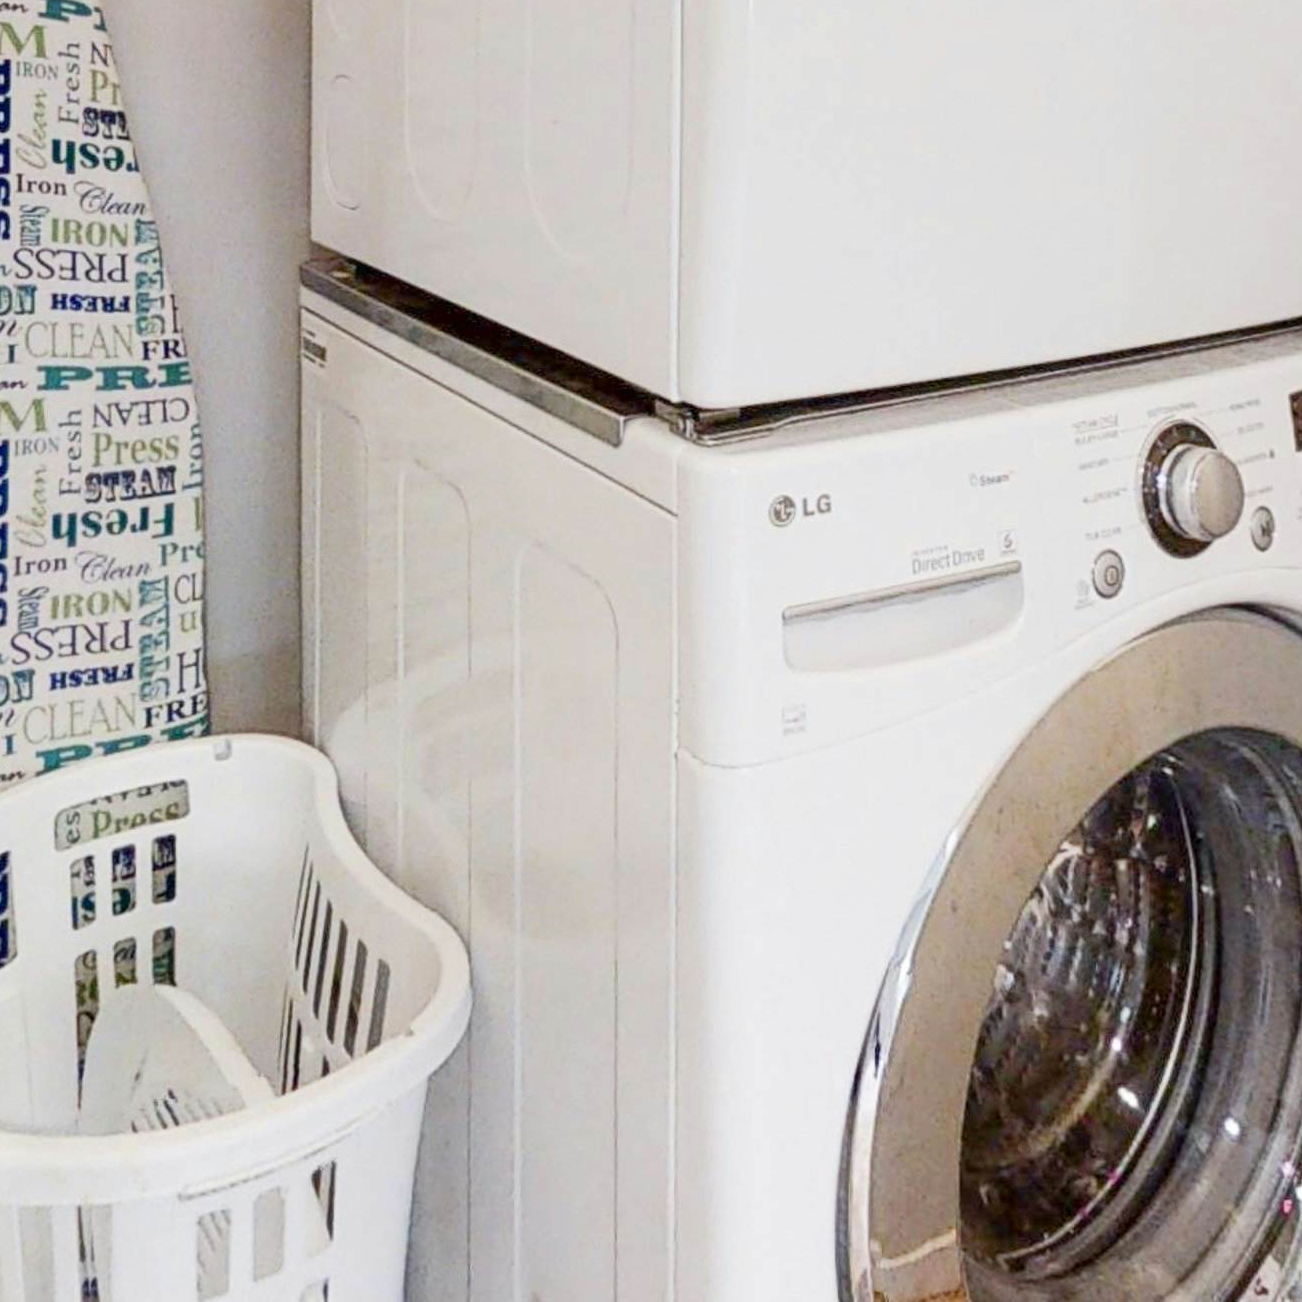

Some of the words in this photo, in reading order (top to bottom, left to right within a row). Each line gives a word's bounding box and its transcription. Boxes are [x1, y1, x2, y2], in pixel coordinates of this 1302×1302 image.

[16, 60, 59, 81] IRON
[57, 42, 80, 124] Fresh
[16, 173, 68, 196] Iron
[73, 180, 147, 216] Clean
[51, 217, 129, 247] IRON
[13, 247, 129, 283] PRESS
[50, 293, 131, 314] FRESH
[25, 321, 134, 360] CLEAN
[91, 397, 191, 429] CLEAN
[14, 437, 60, 458] IRON
[58, 409, 82, 496] Fresh
[91, 431, 180, 467] Press
[84, 464, 178, 504] STEAM
[13, 463, 47, 548] Clean
[802, 494, 832, 517] LG
[51, 502, 175, 548] Fresh
[13, 555, 68, 577] Iron
[74, 549, 151, 584] Clean
[912, 555, 951, 575] Direct
[952, 548, 985, 567] Drive
[50, 587, 133, 619] IRON
[10, 619, 134, 666] PRESS
[138, 575, 171, 703] STEAM
[49, 662, 135, 691] FRESH
[22, 693, 137, 746] CLEAN
